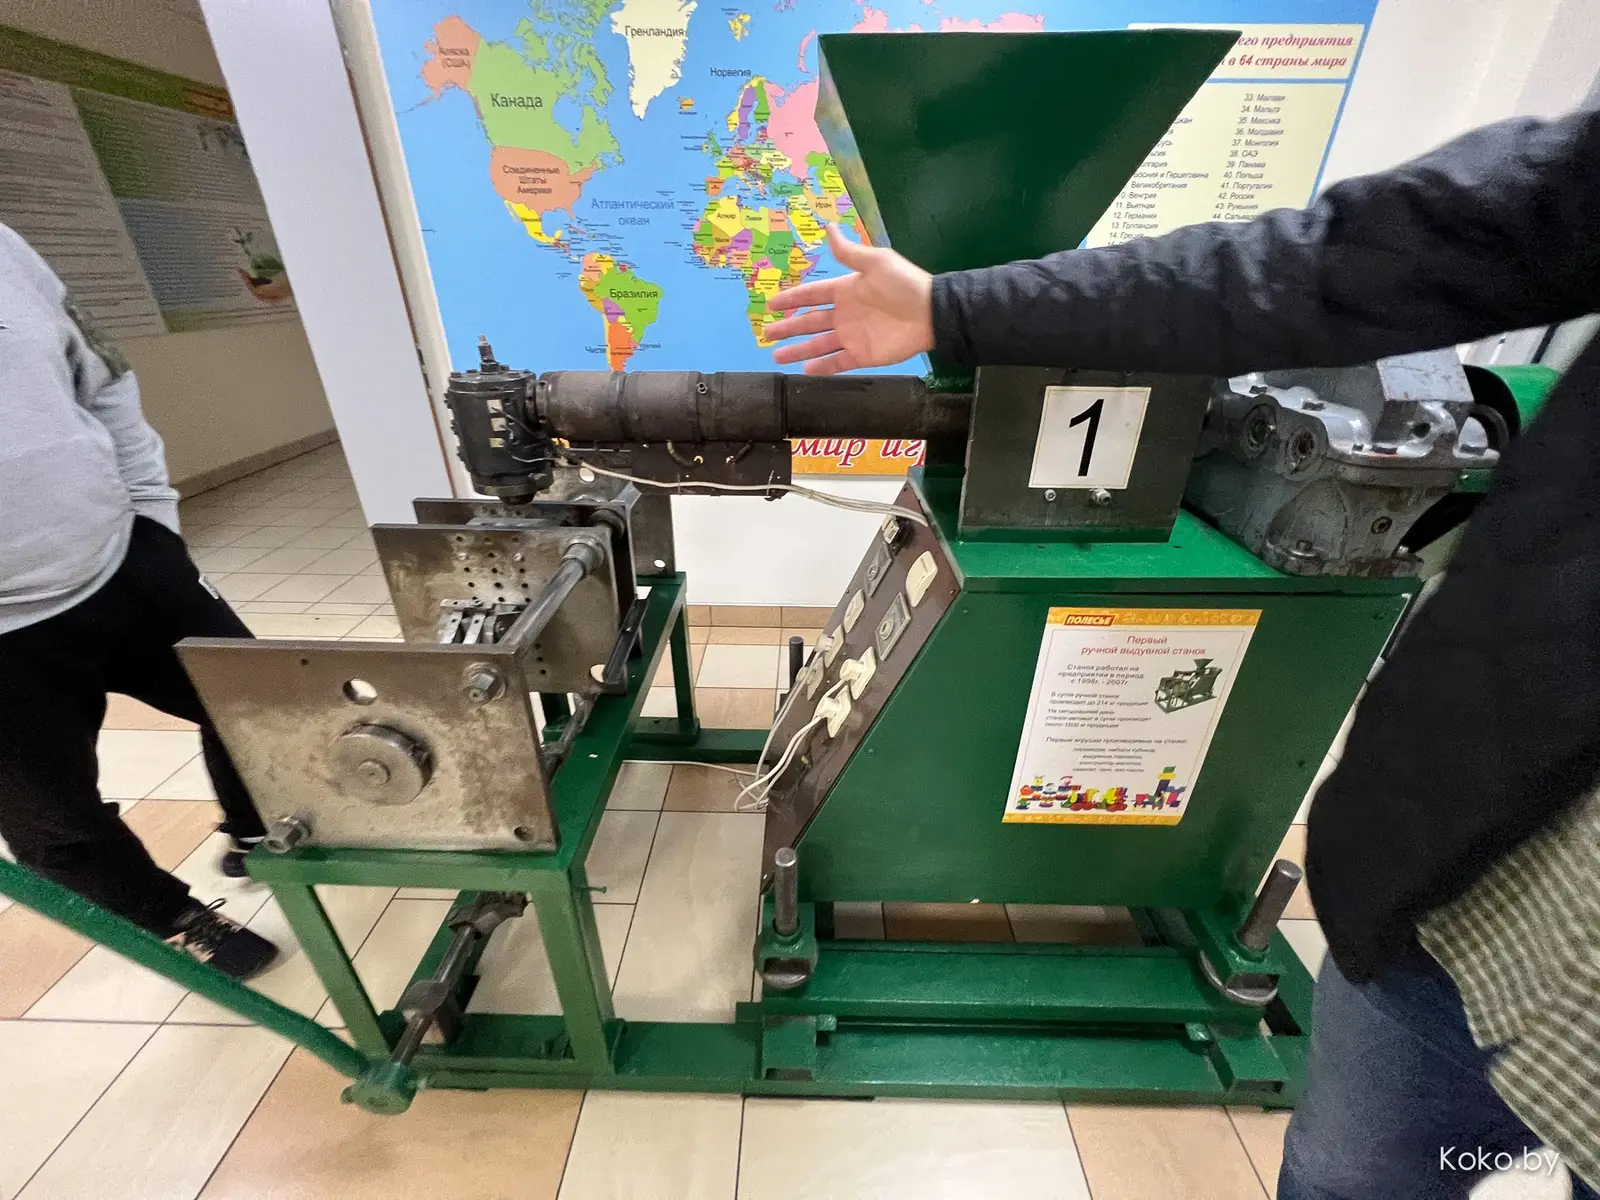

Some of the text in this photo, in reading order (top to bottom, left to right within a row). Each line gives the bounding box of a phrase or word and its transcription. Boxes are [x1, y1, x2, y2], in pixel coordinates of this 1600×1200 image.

[624, 25, 685, 38] Гренландия
[1238, 33, 1354, 49] его предприятия
[1239, 54, 1254, 66] 64
[1255, 57, 1309, 69] страны
[1311, 57, 1348, 69] мира
[710, 67, 752, 78] Норвегия
[490, 92, 544, 110] Канада
[502, 164, 560, 175] Соединенные
[591, 197, 675, 210] Атлантический
[618, 216, 650, 226] океан
[609, 288, 659, 300] Бразилия
[1069, 398, 1104, 476] 1
[1066, 615, 1113, 625] ПОЛЕСЬЕ
[1126, 635, 1168, 646] Первый
[1081, 646, 1206, 656] ручной выдувной станок
[1067, 663, 1094, 671] Станок
[1096, 664, 1128, 672] работал
